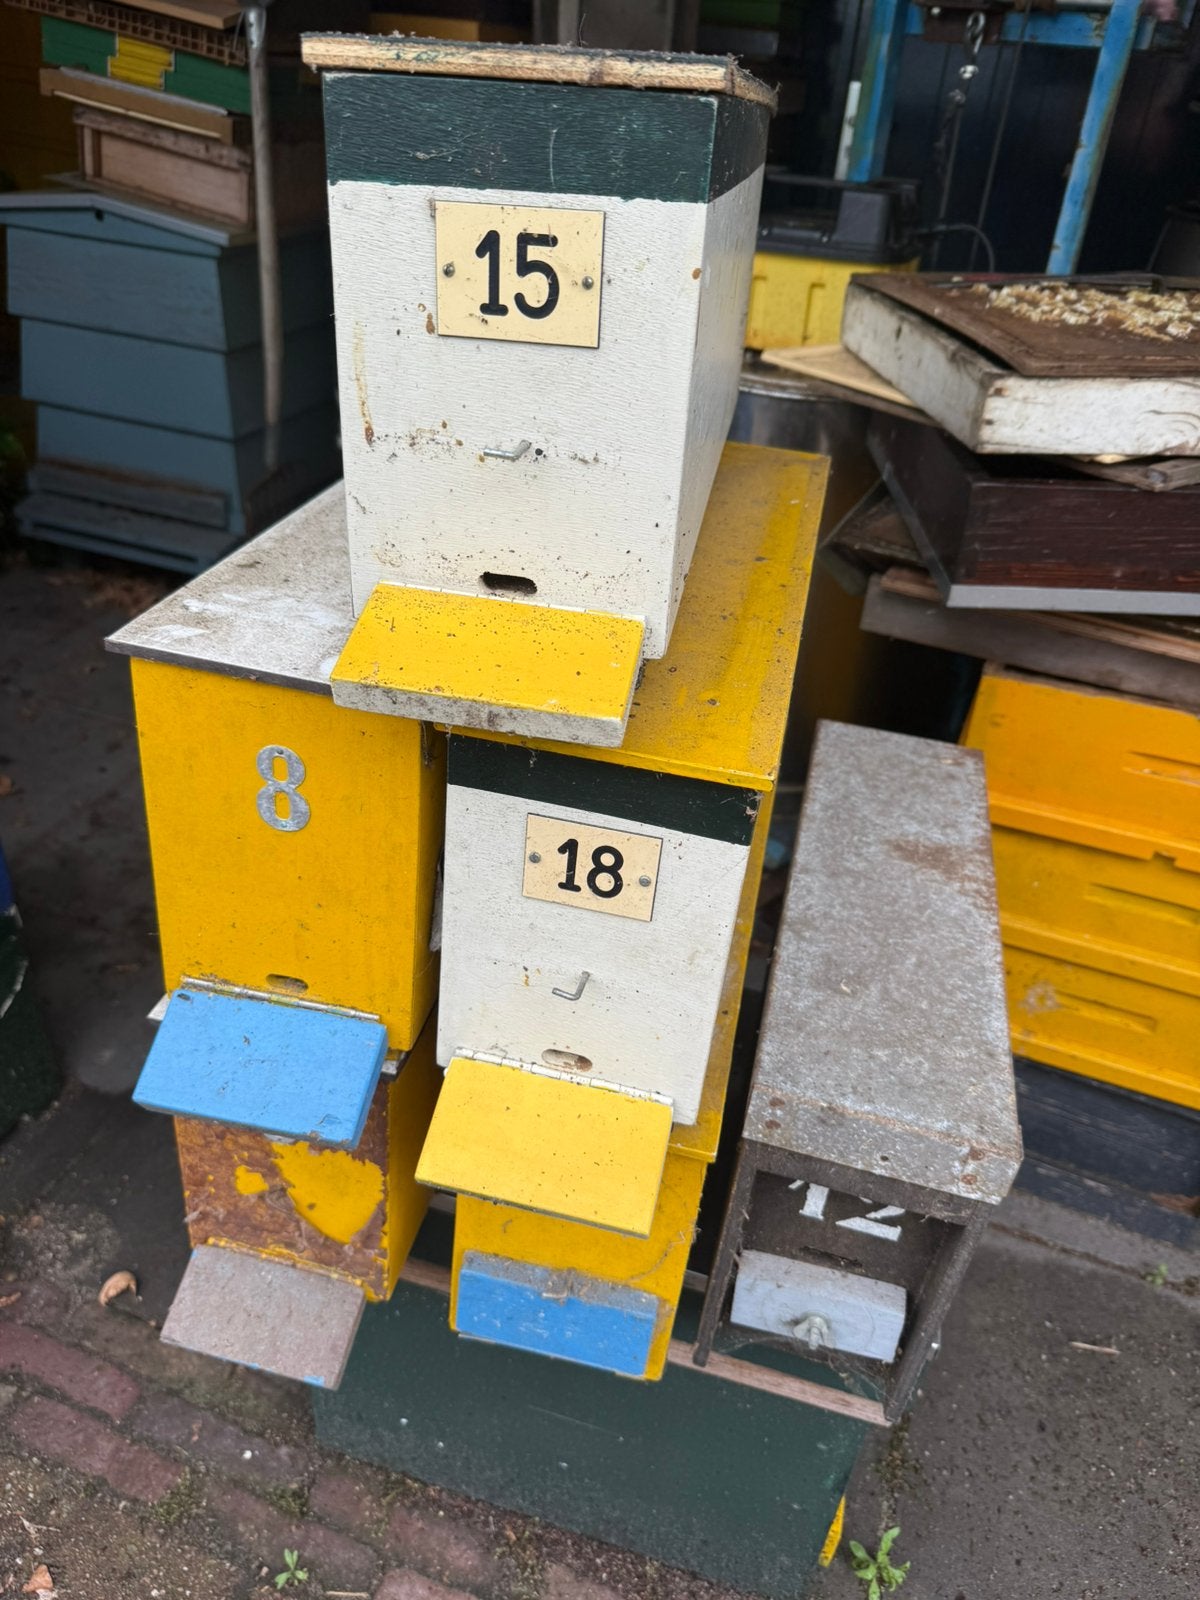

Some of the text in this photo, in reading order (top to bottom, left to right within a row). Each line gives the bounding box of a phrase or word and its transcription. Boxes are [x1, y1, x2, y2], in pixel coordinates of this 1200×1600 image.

[475, 230, 560, 319] 15
[256, 744, 311, 832] 8
[557, 838, 624, 898] 18
